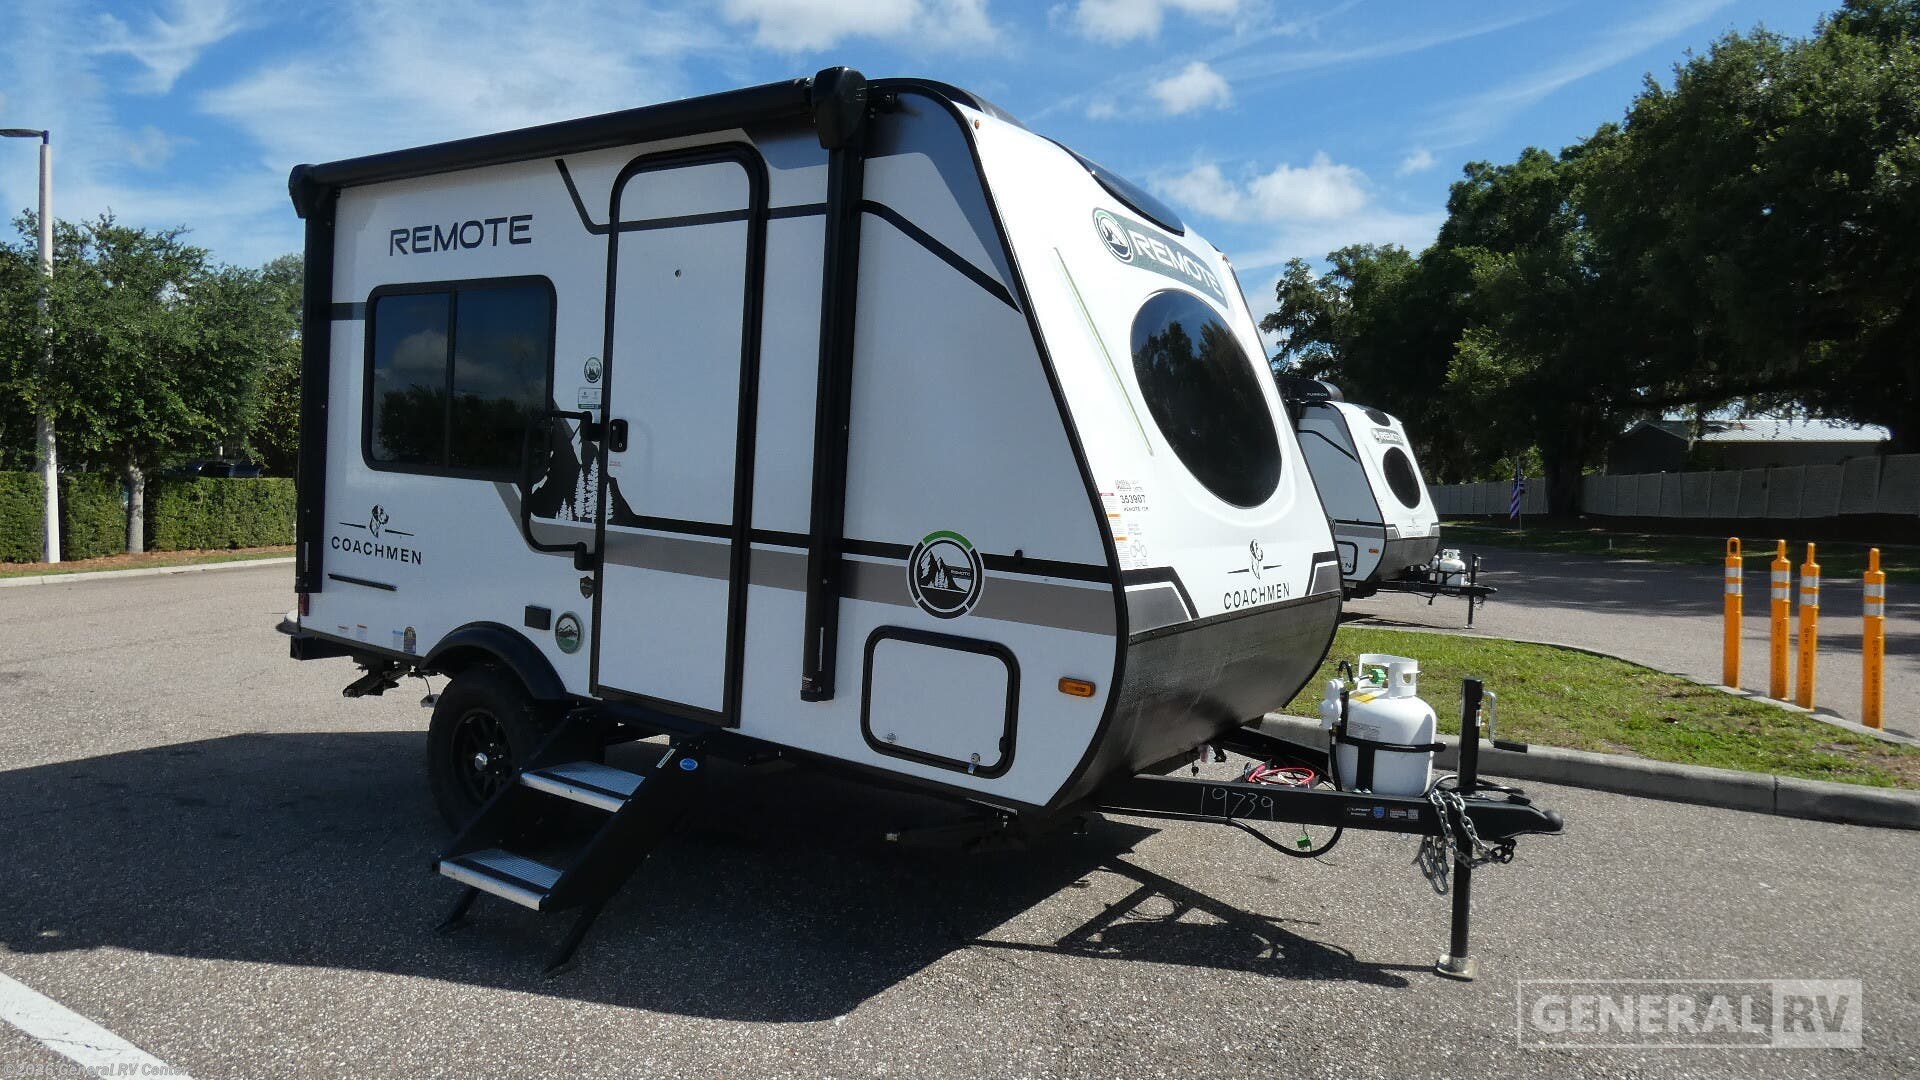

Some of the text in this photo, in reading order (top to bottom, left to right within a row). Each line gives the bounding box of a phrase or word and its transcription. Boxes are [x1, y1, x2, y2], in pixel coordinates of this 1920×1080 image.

[389, 214, 533, 256] REMOTE
[1127, 229, 1224, 298] REMOTE
[331, 536, 422, 565] COACHMEN
[1223, 582, 1290, 610] COACHMEN
[1200, 786, 1274, 820] 19739
